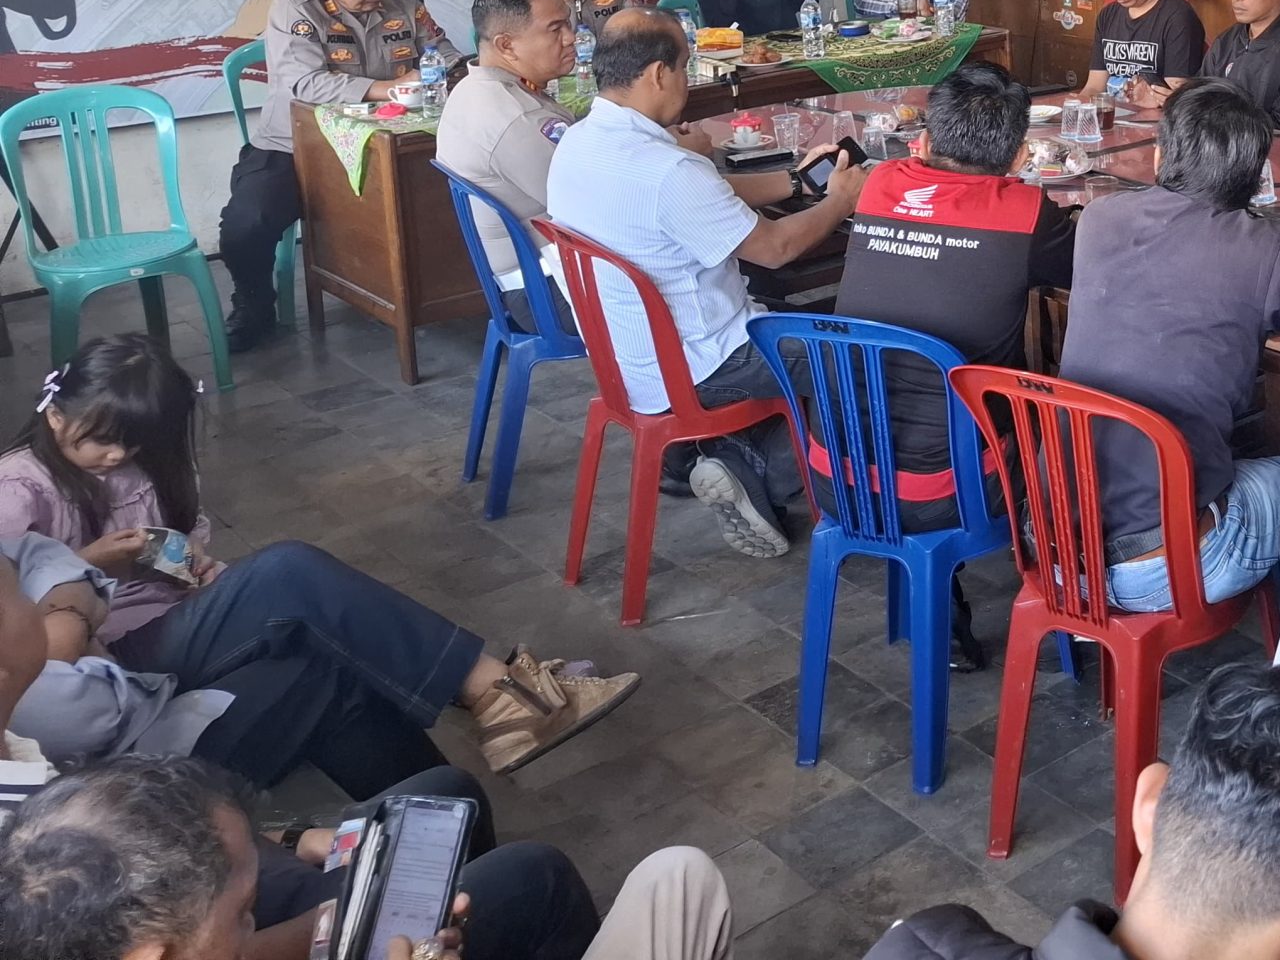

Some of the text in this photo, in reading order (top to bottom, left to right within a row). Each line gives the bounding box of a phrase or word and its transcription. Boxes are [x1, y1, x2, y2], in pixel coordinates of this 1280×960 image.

[382, 30, 411, 44] POLRI
[908, 208, 934, 218] HEART
[867, 225, 894, 238] BUNDA
[896, 230, 904, 240] &
[906, 231, 942, 245] BUNDA
[945, 237, 980, 249] motor
[867, 238, 939, 260] PAYAKUMBUH
